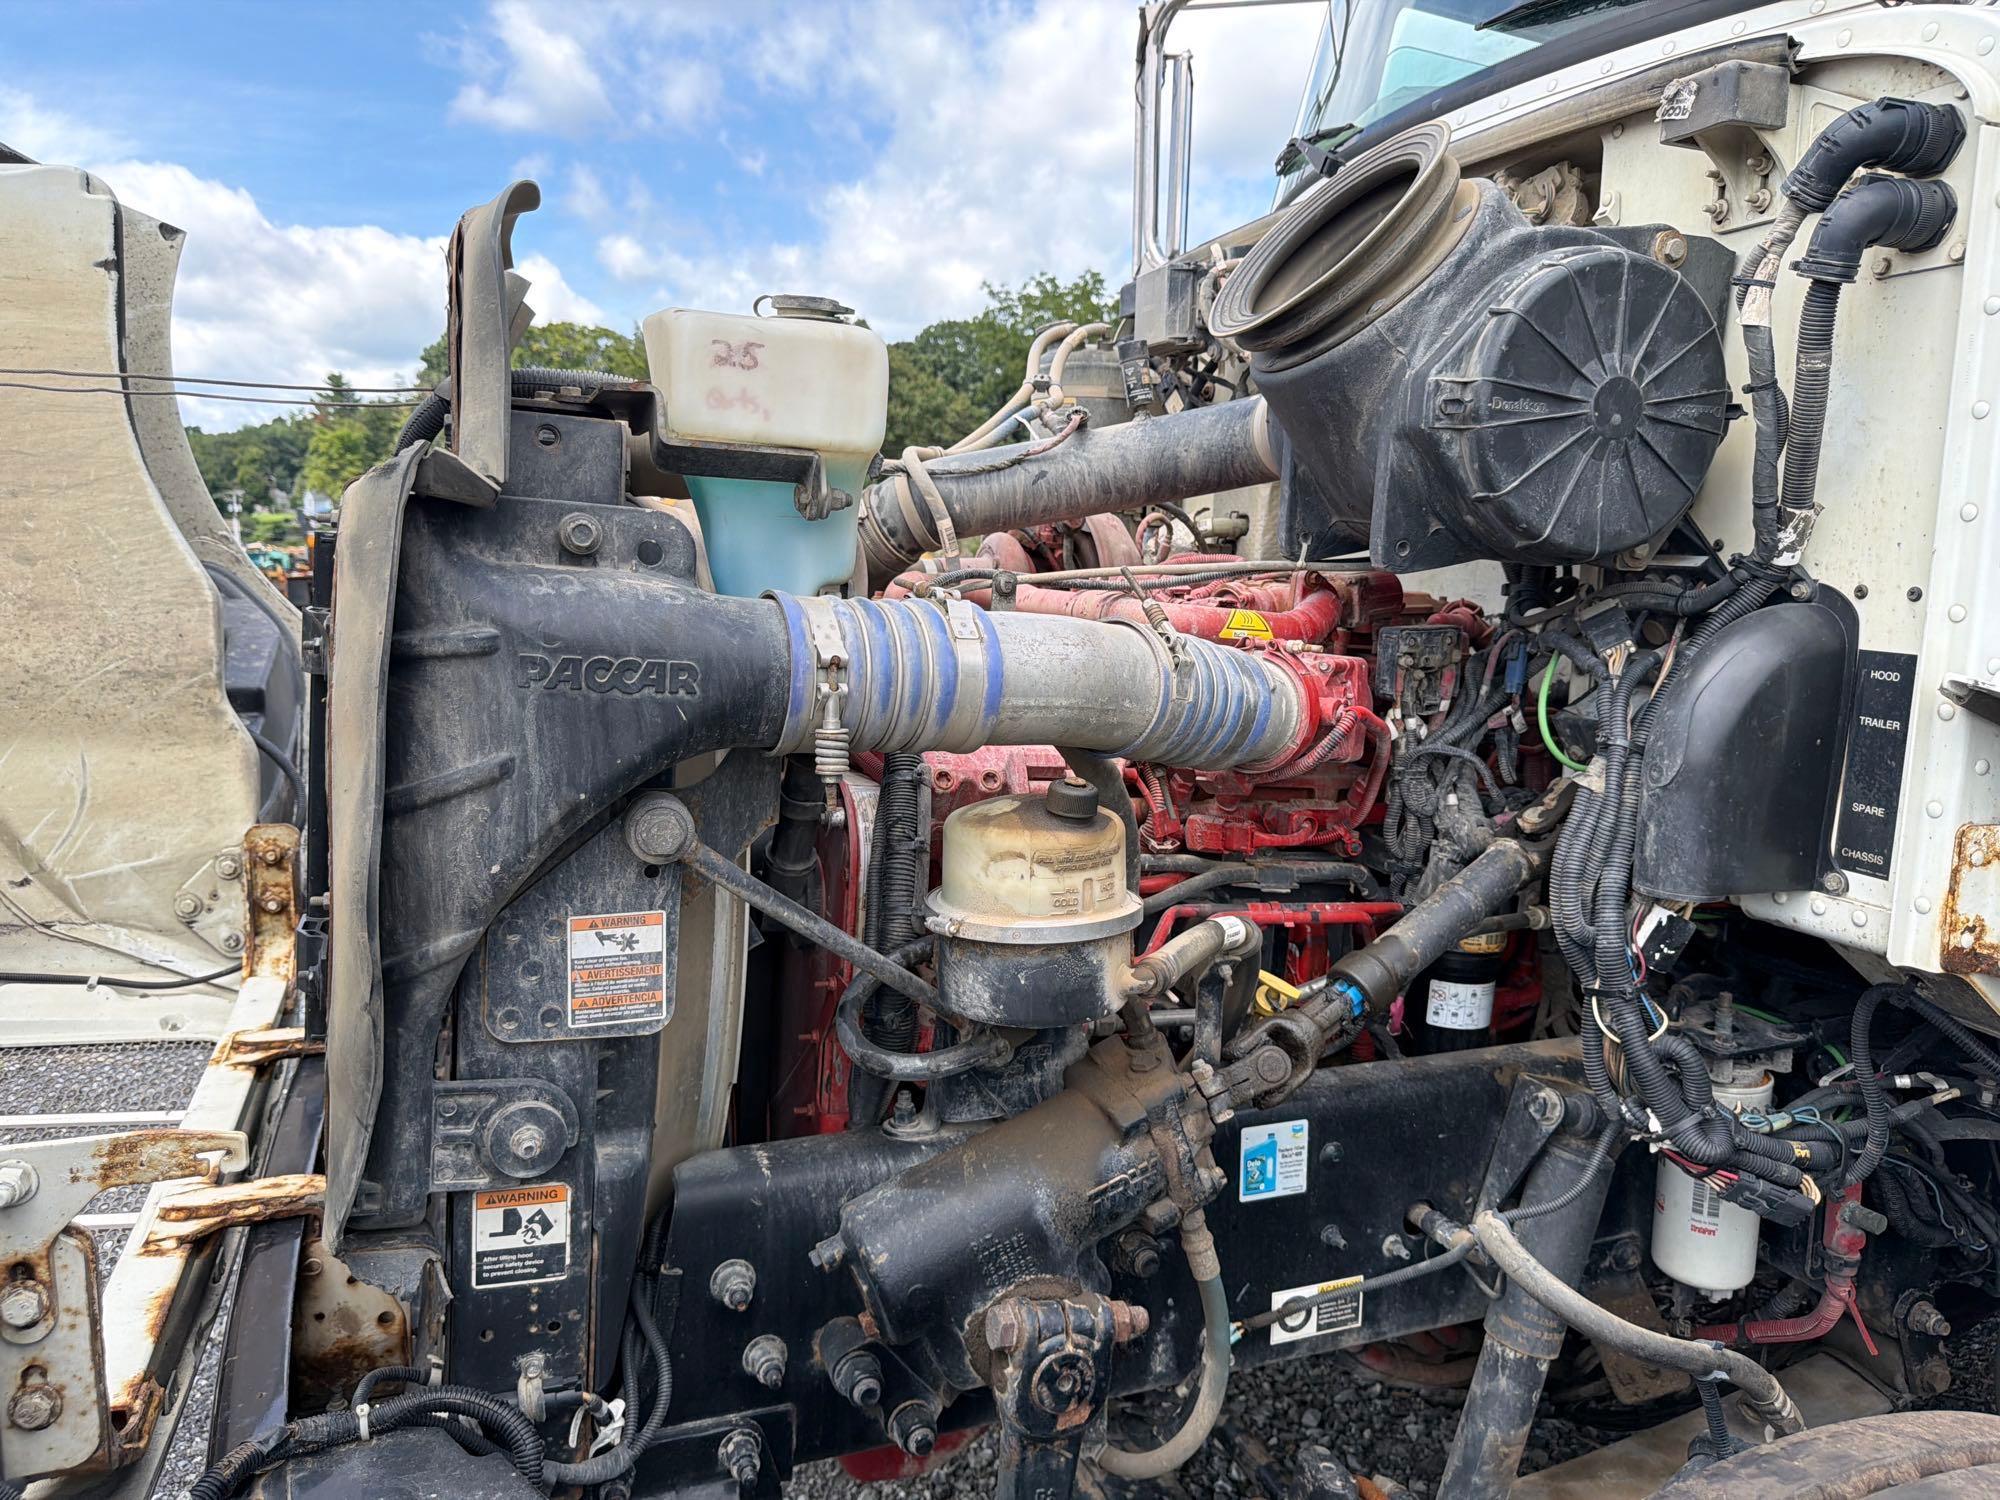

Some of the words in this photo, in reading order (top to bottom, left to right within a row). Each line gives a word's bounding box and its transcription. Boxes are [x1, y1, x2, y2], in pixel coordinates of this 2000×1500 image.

[517, 653, 701, 695] PACCAR
[1870, 670, 1901, 682] HOOD
[1859, 716, 1901, 731] TRAILER
[1851, 802, 1886, 818] SPARE
[1841, 847, 1884, 865] CHASSIS
[1053, 898, 1079, 908] COLD
[601, 916, 646, 927] WARNING
[587, 965, 661, 979] AVERTISSEMENT
[592, 992, 657, 1006] ADVERTENCIA
[1247, 1159, 1261, 1167] Delo
[497, 1189, 558, 1203] WARNING
